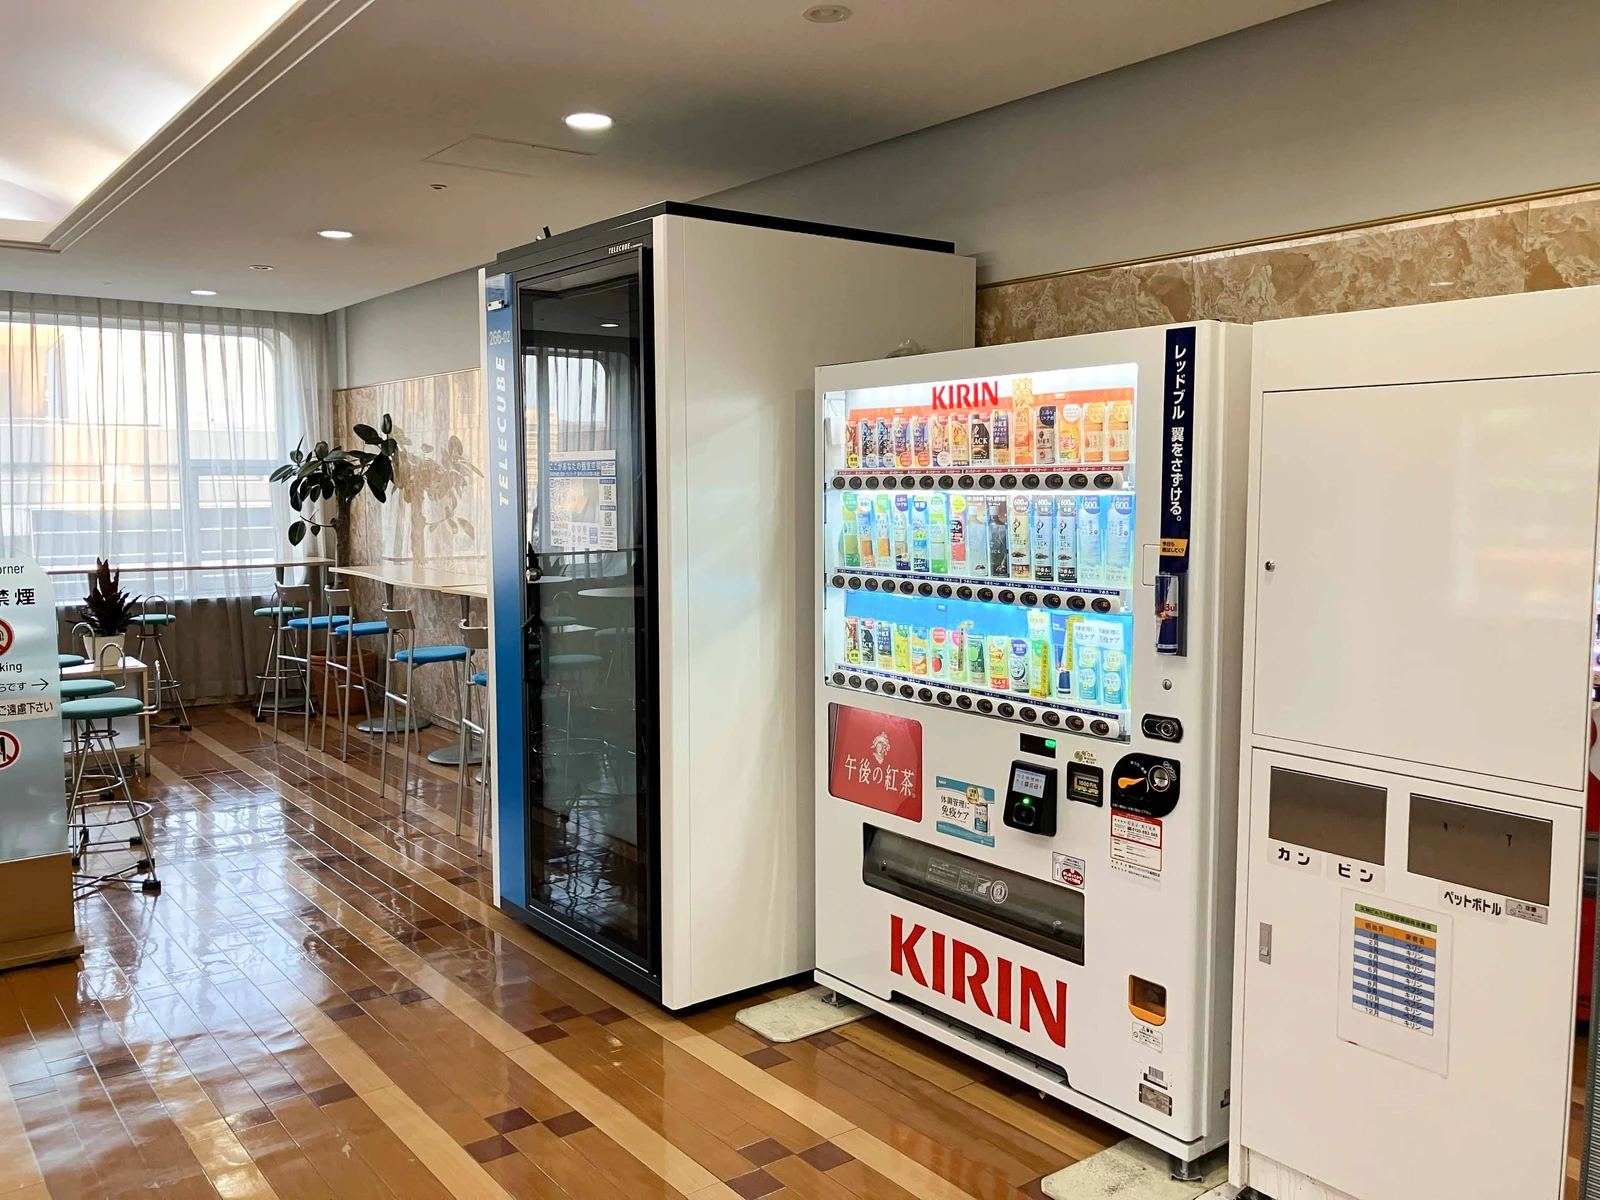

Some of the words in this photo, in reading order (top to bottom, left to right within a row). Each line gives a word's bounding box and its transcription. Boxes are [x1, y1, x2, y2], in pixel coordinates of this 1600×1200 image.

[931, 380, 999, 411] KIRIN
[1171, 344, 1187, 420] レッドブル
[495, 356, 509, 506] TELECUBE
[1169, 427, 1184, 522] 翼をさずける。
[844, 753, 915, 797] 午後の紅茶
[940, 795, 970, 810] 体調管理に
[941, 804, 970, 821] 免疫ケア
[1278, 847, 1310, 866] カン
[1338, 863, 1374, 882] ビン
[1443, 891, 1502, 916] ペットボトル
[890, 914, 1068, 1049] KIRIN
